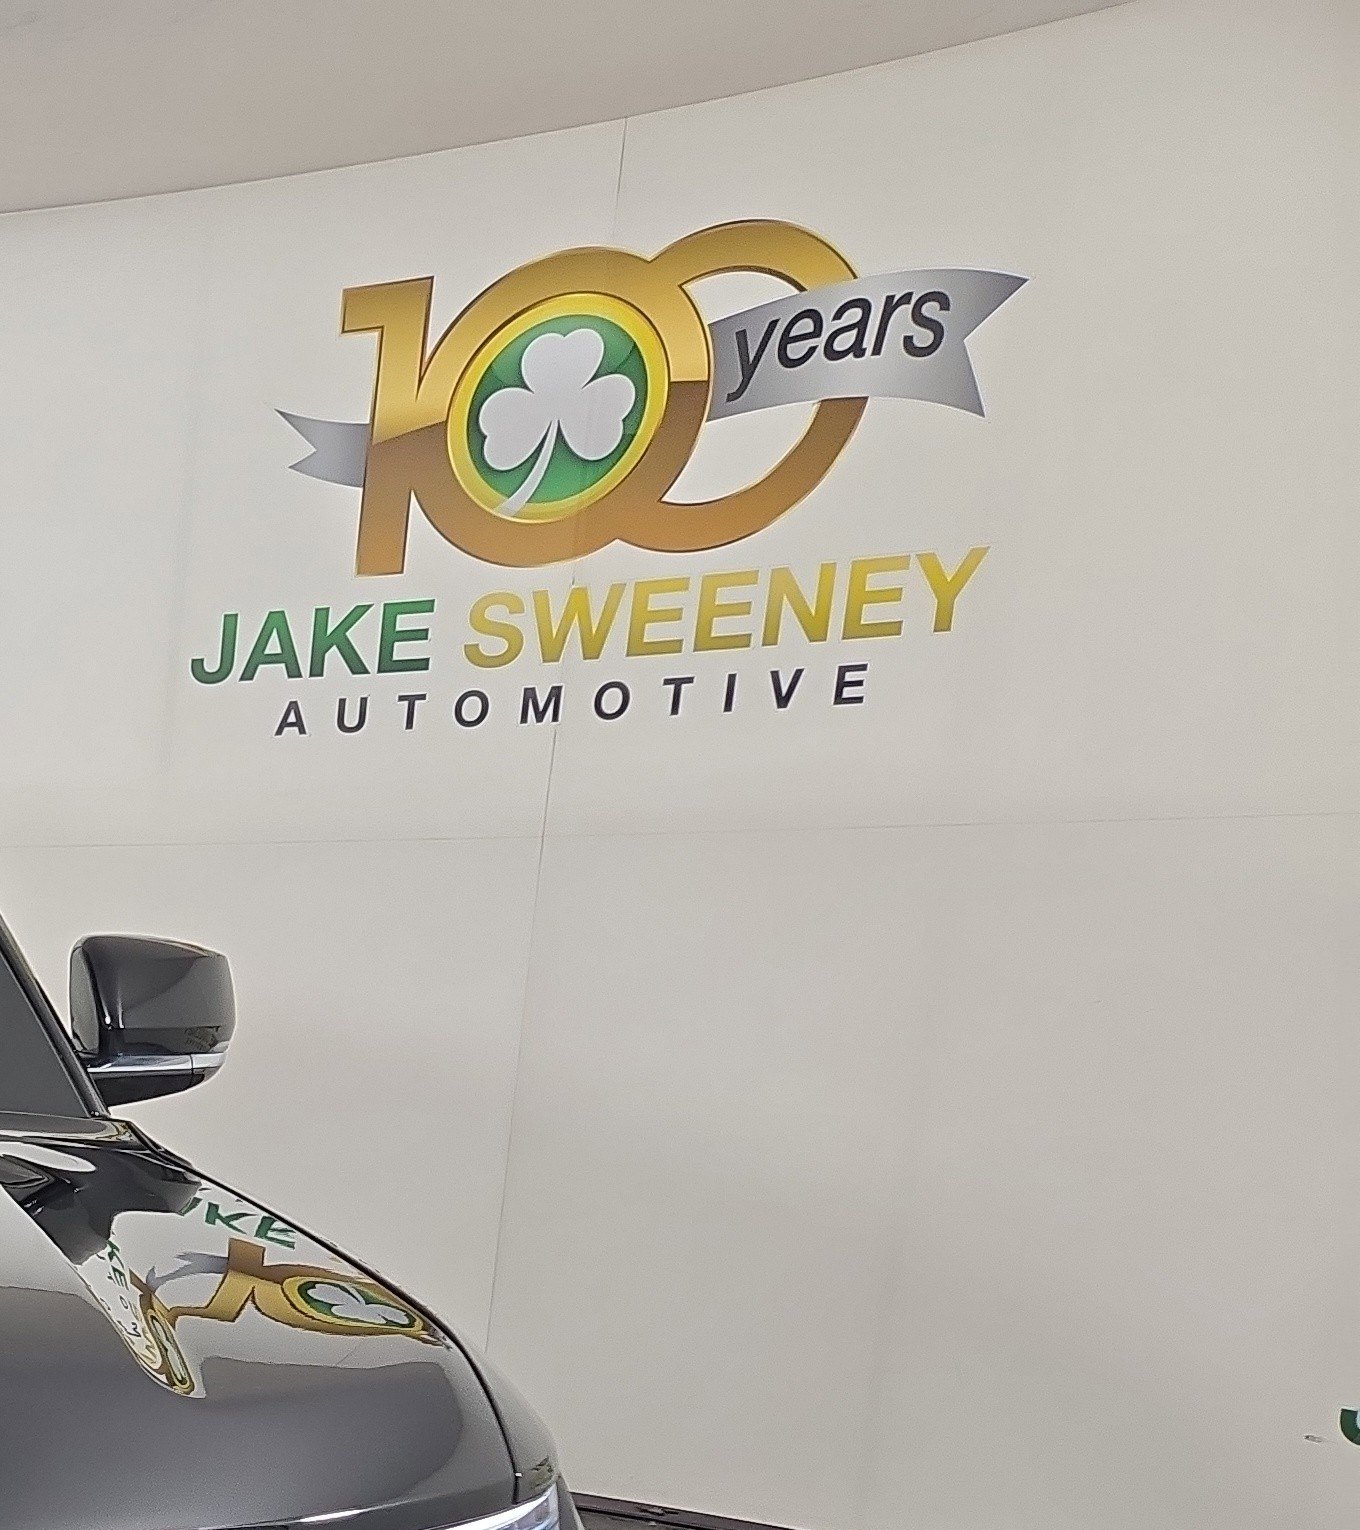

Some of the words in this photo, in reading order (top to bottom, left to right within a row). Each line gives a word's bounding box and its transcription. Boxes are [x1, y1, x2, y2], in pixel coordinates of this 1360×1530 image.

[726, 290, 951, 402] years
[191, 600, 435, 684] JAKE
[464, 547, 990, 668] SWEENEY
[275, 662, 869, 736] AUTOMOTIVE
